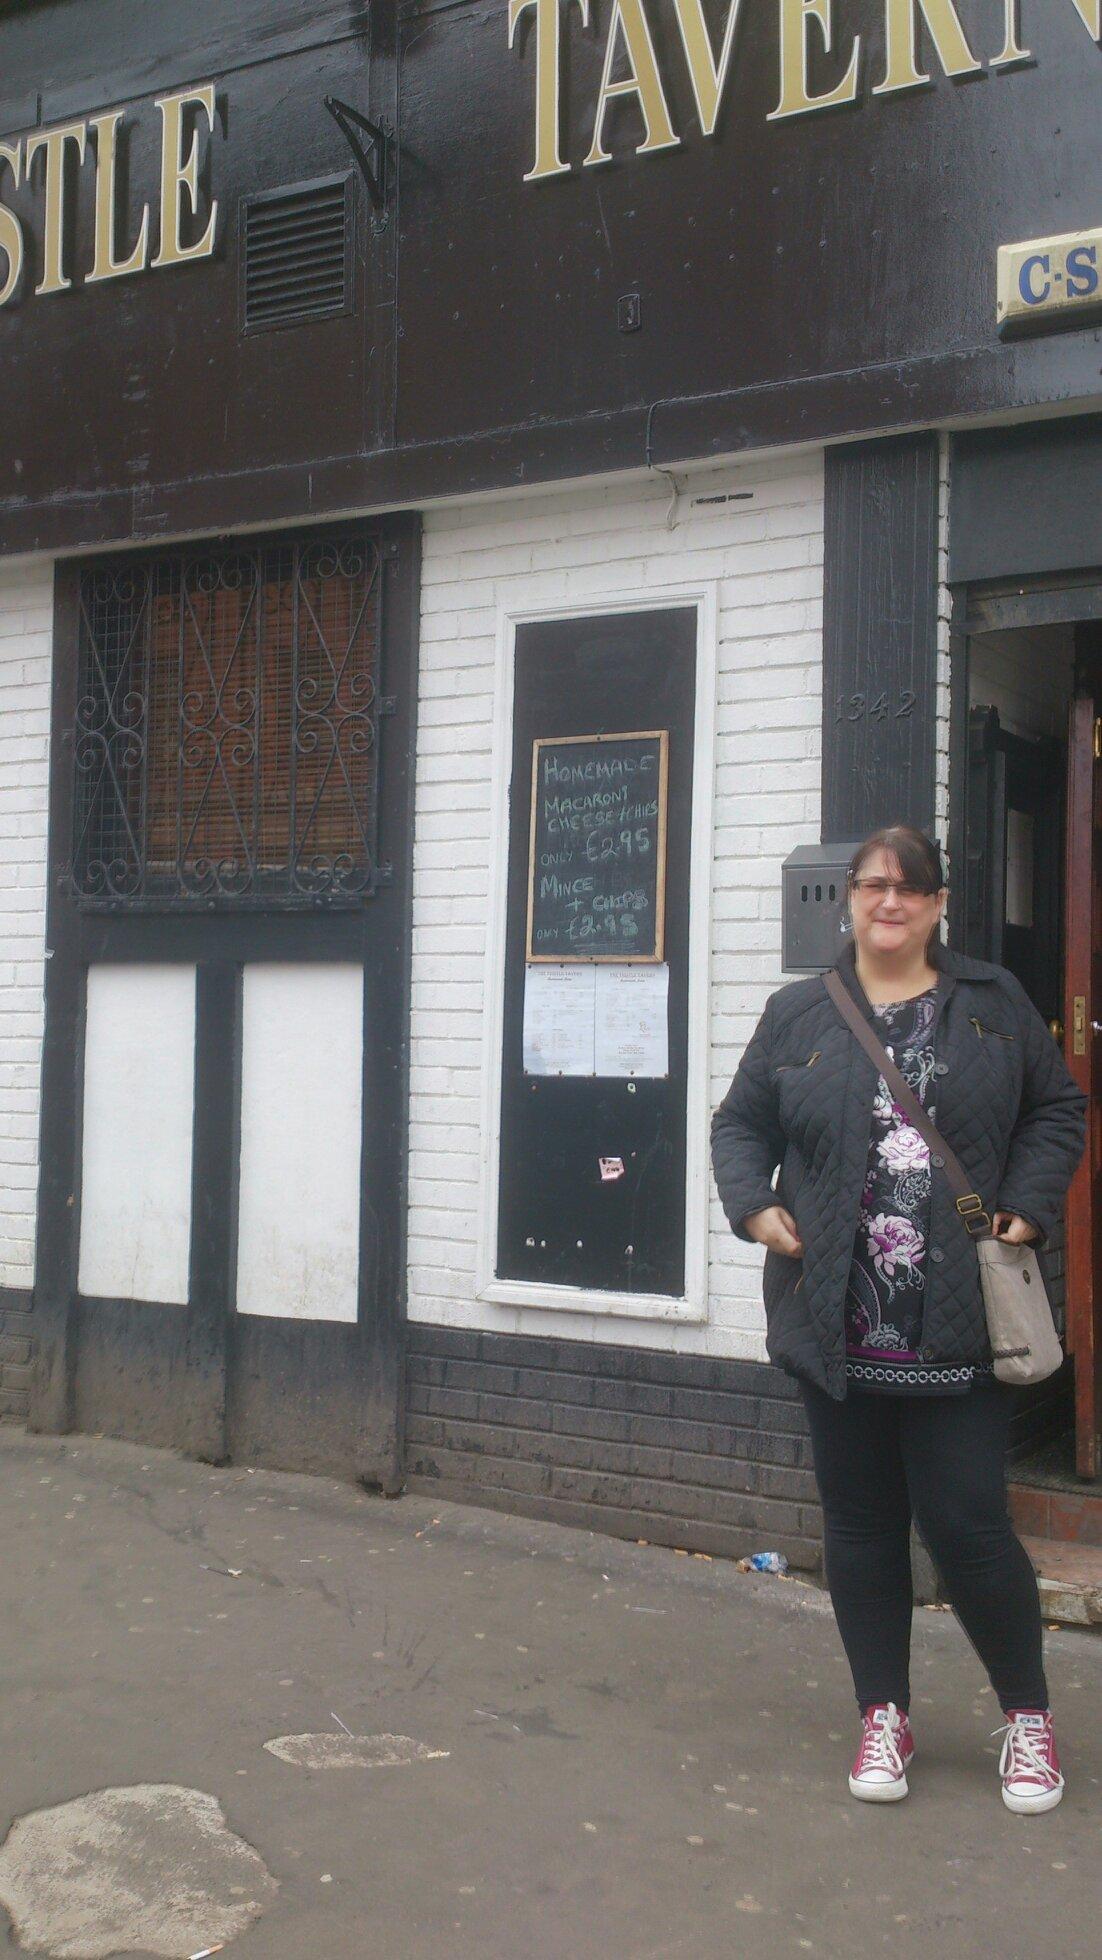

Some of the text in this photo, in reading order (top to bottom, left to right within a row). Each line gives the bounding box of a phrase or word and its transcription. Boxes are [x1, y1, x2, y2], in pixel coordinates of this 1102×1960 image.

[544, 785, 628, 818] MACARONI
[547, 810, 614, 832] CHEESE
[540, 850, 573, 866] ONLY
[540, 874, 594, 898] MINCE
[592, 888, 649, 911] CHIPS
